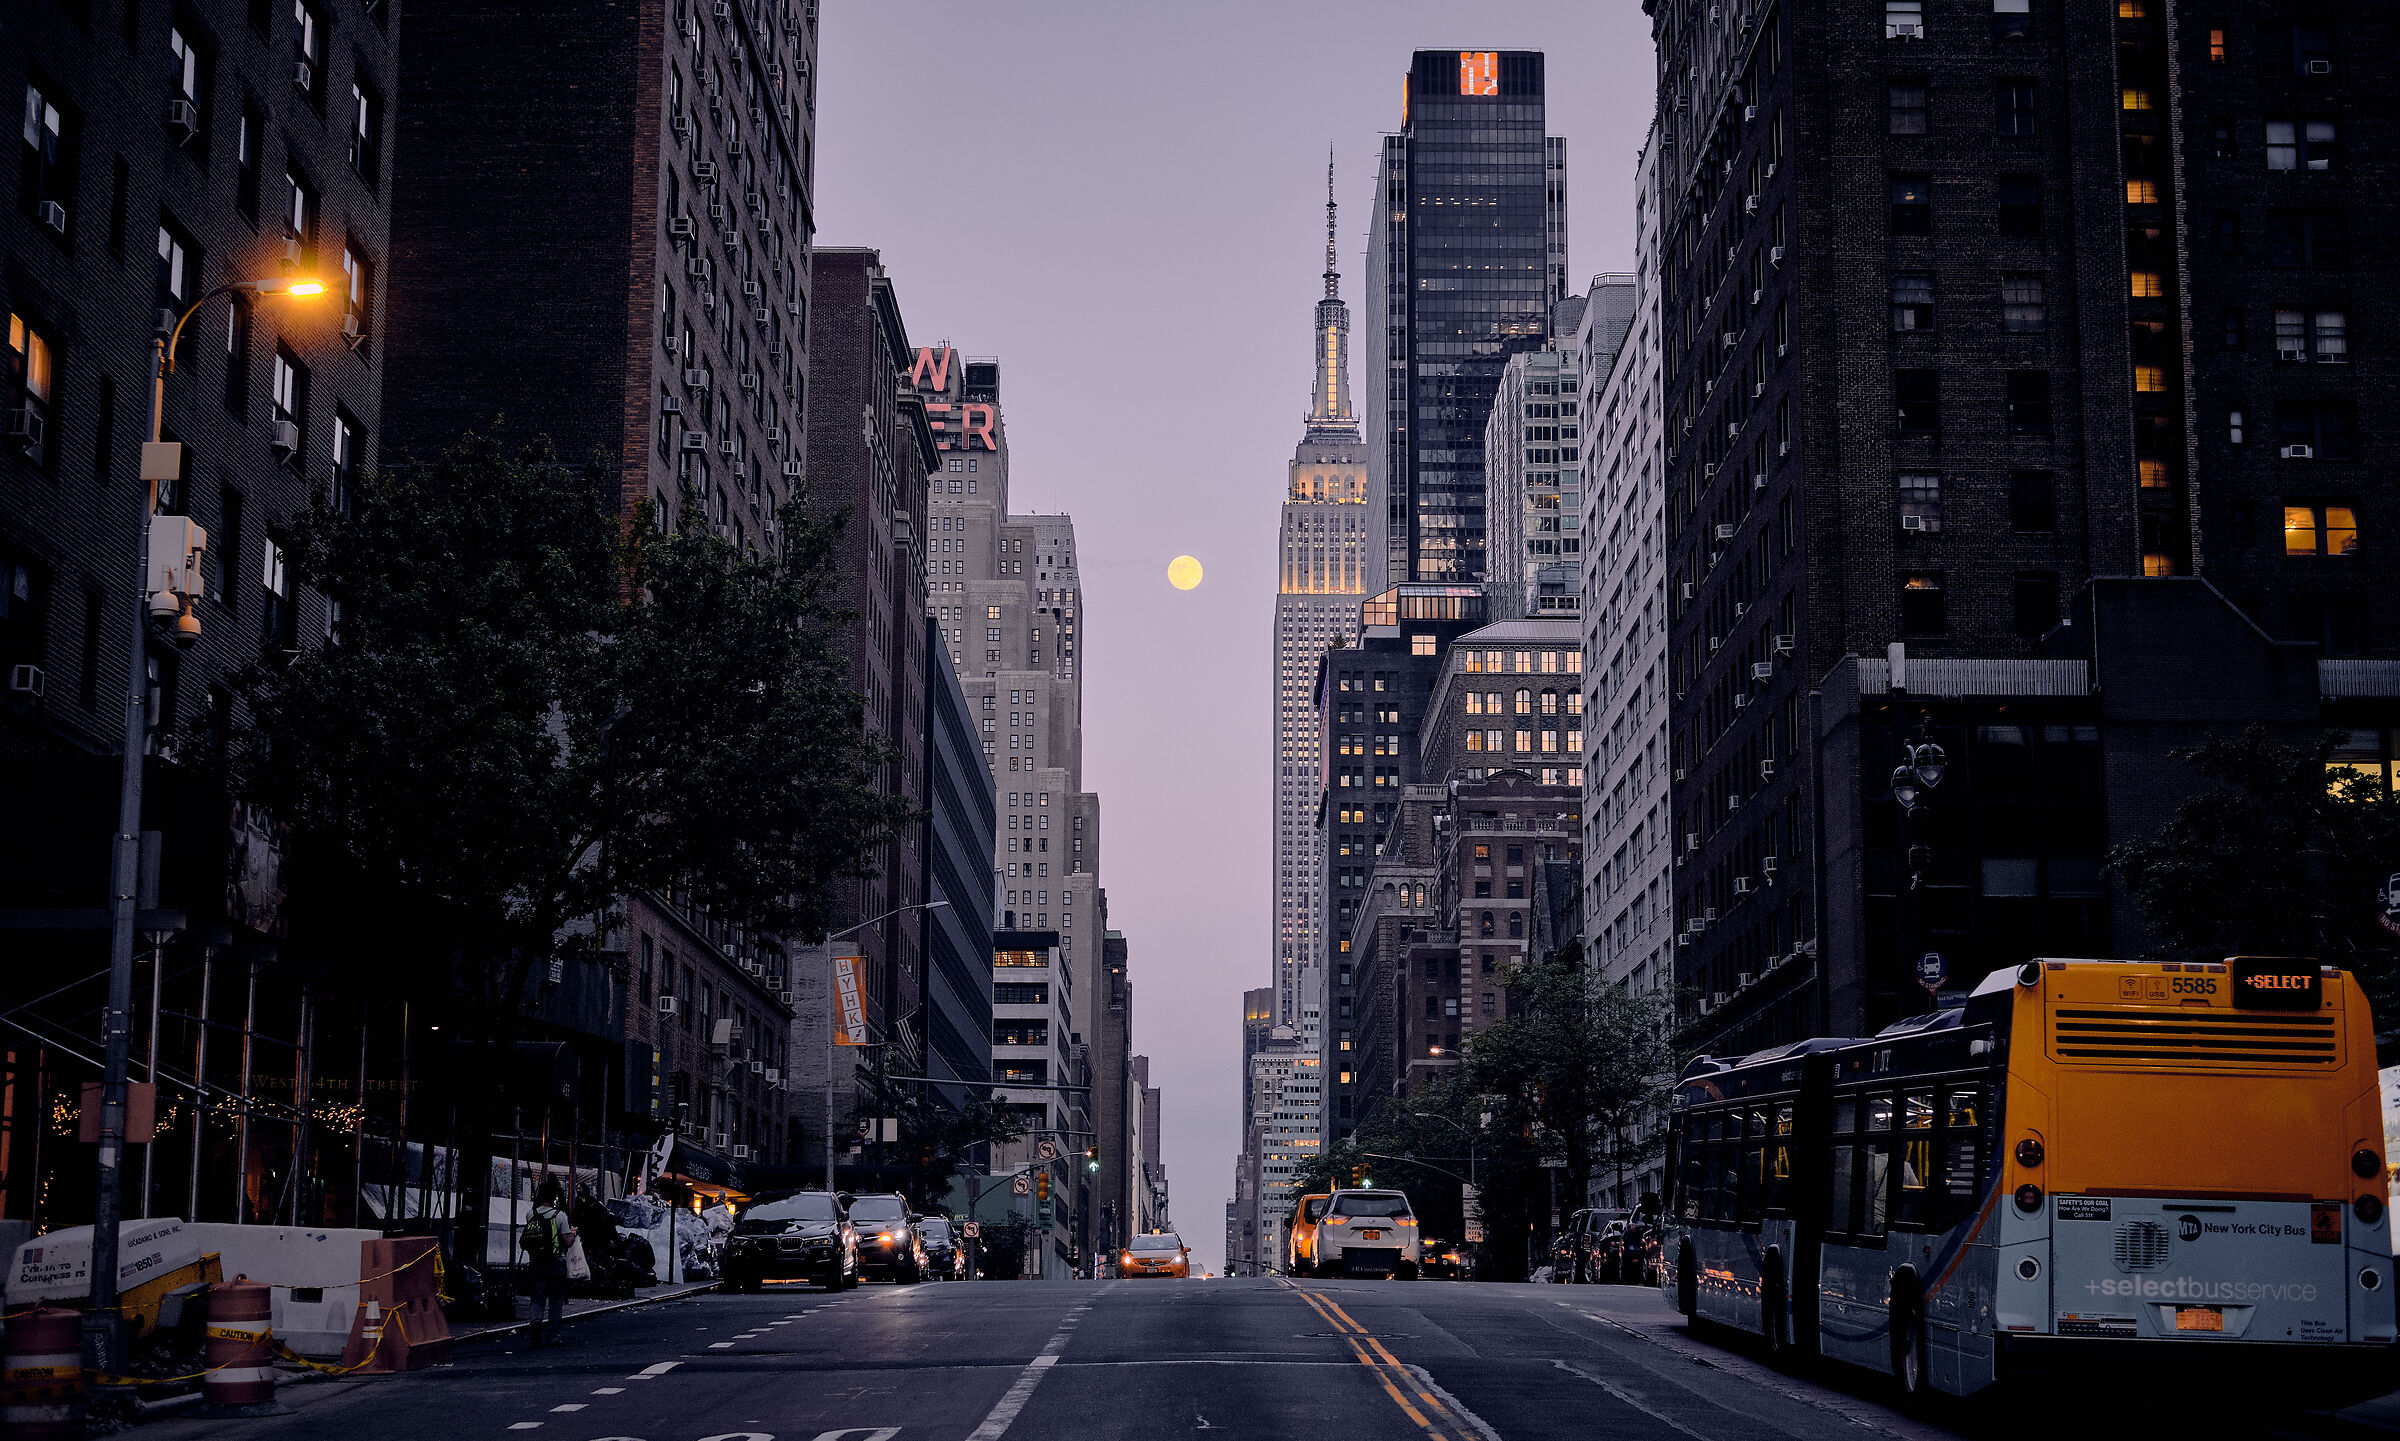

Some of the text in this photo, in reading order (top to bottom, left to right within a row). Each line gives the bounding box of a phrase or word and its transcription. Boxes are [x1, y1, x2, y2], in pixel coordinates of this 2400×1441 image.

[2171, 977, 2217, 994] 5585
[158, 1228, 171, 1237] SONS
[2178, 1219, 2199, 1236] MTA
[2204, 1222, 2306, 1237] New York City Bus
[134, 1256, 154, 1272] 185D
[220, 1329, 254, 1341] CAUTION
[14, 1367, 54, 1378] CAUTION
